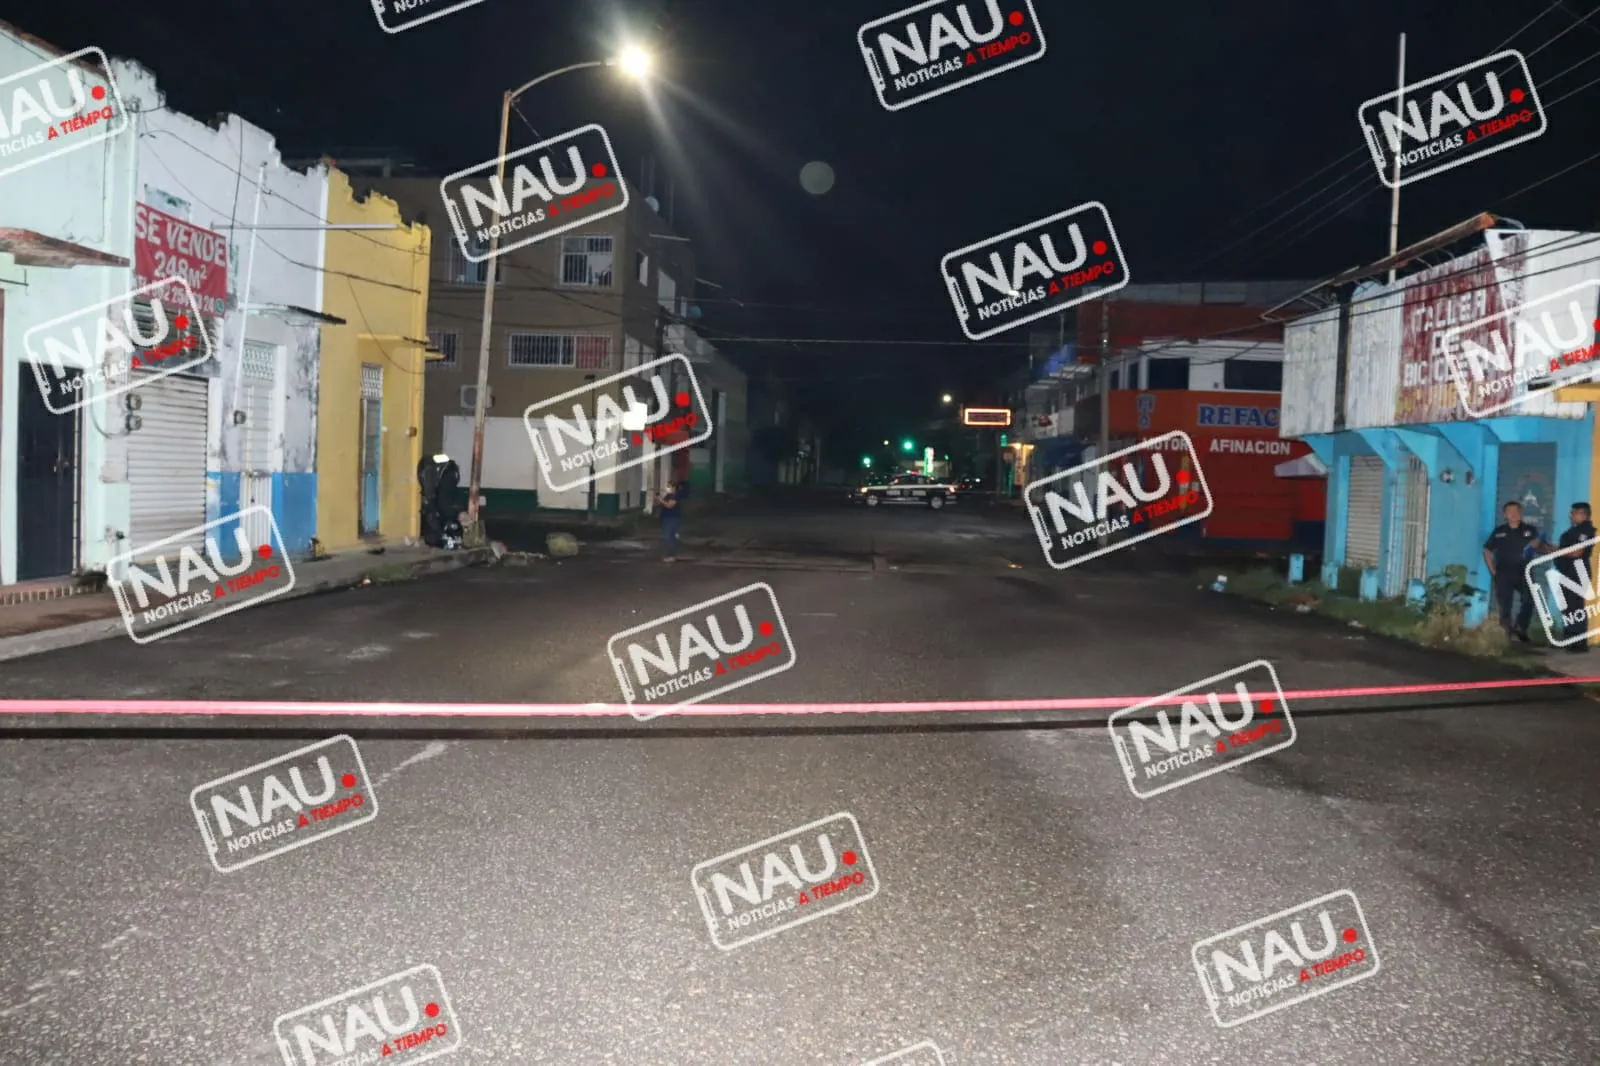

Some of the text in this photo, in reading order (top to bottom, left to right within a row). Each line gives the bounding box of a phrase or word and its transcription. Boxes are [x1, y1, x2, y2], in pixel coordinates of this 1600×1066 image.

[135, 205, 226, 268] SE VENDE
[1198, 403, 1280, 428] REFAC
[1210, 438, 1291, 455] AFINACION
